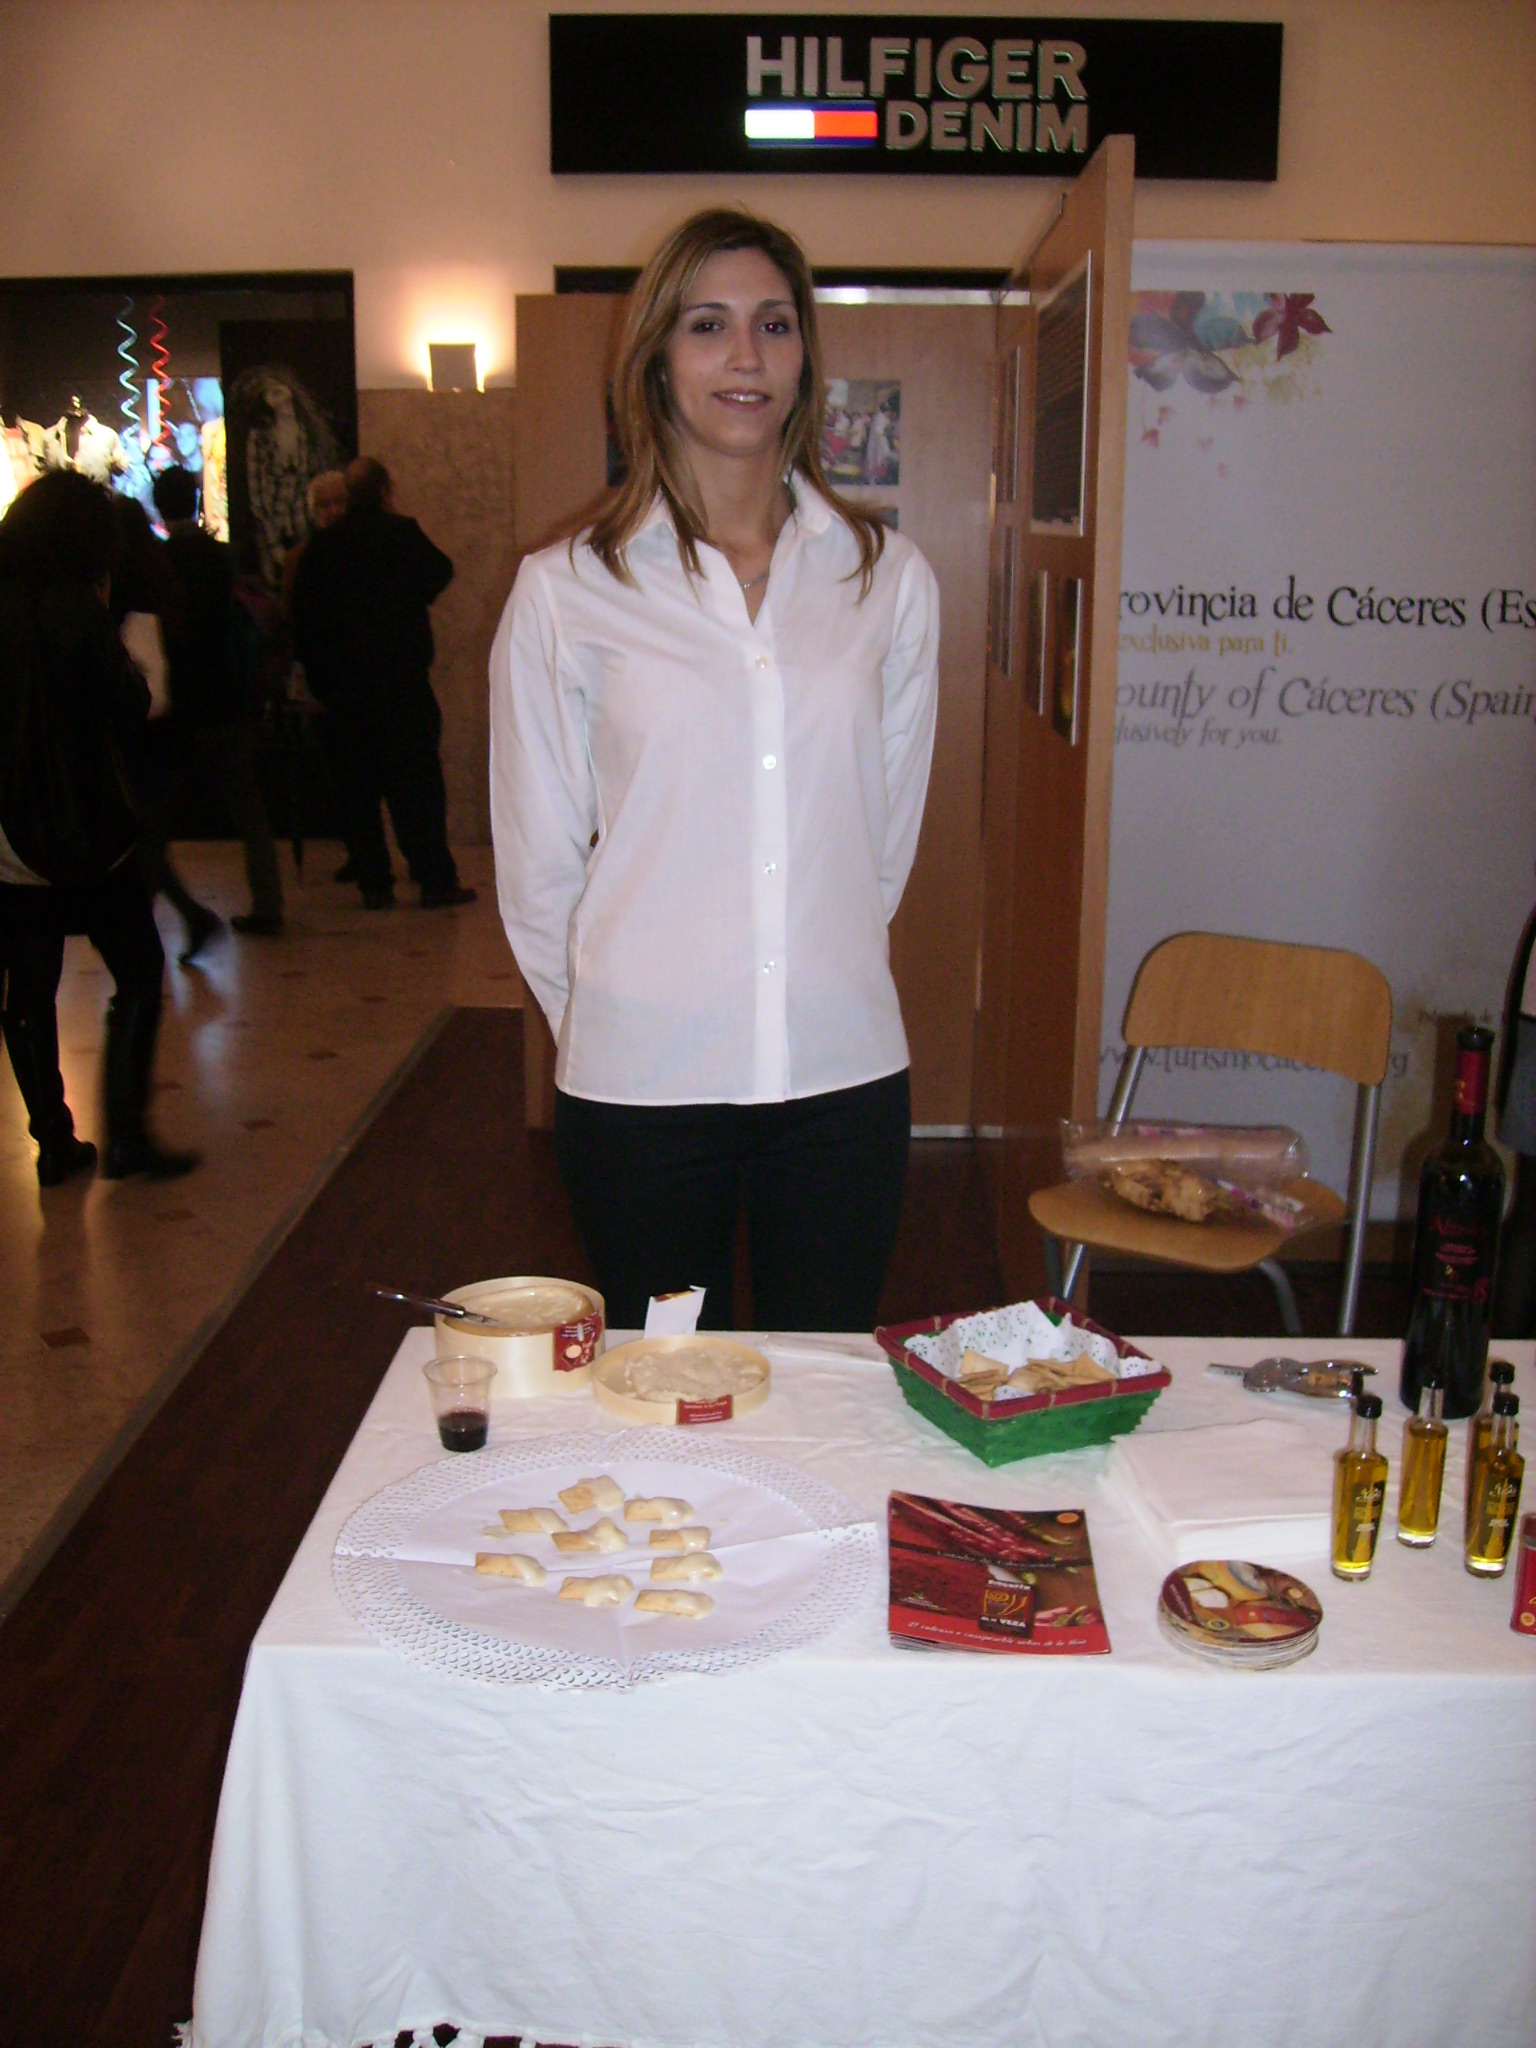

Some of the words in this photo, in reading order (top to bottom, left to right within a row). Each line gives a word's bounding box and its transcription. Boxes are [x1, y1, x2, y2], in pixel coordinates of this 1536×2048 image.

[746, 36, 1088, 100] HILFIGER
[886, 101, 1089, 153] DENIM
[1119, 584, 1257, 627] rovincia
[1273, 574, 1314, 622] de
[1327, 586, 1466, 627] Cáceres
[1481, 587, 1536, 632] (Es
[1117, 667, 1217, 720] ounty
[1229, 665, 1276, 717] of
[1279, 677, 1418, 718] Cáceres
[1115, 714, 1192, 748] lusively
